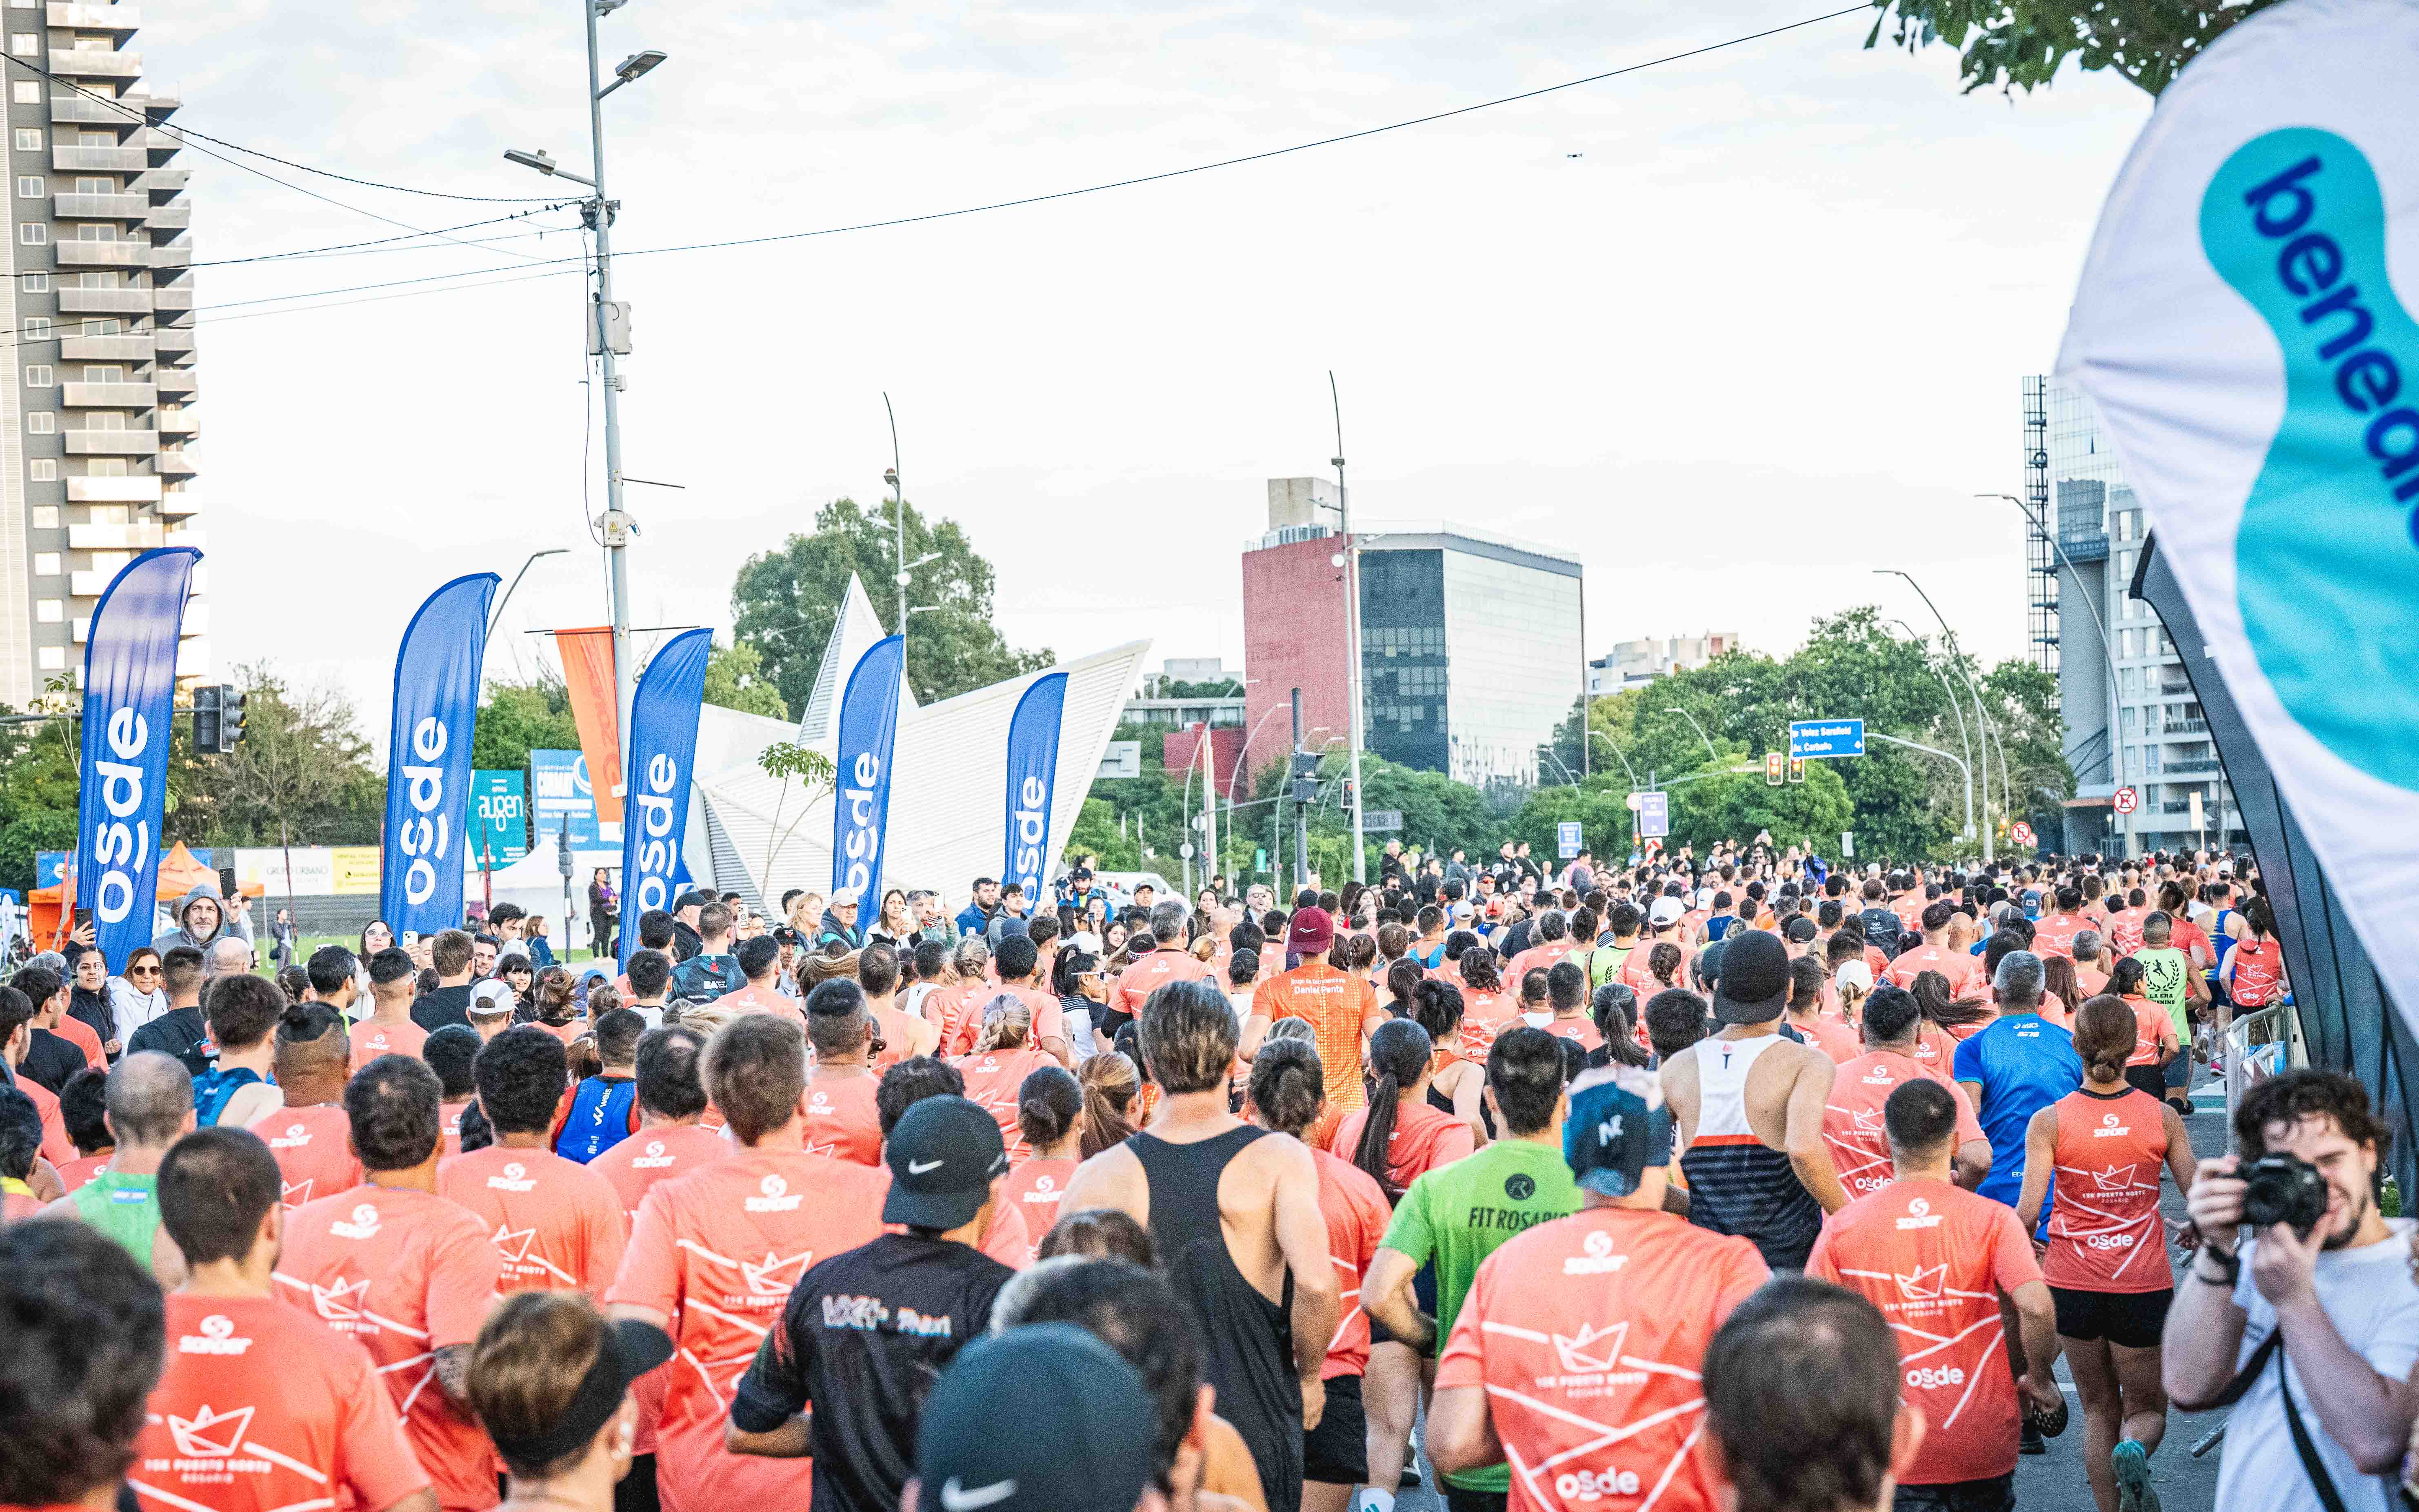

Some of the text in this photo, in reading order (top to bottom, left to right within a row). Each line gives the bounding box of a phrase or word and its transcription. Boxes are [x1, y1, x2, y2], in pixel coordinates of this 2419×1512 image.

[96, 706, 148, 923] osde
[401, 716, 448, 905] osde
[478, 795, 523, 831] augen
[638, 753, 676, 913] osde
[845, 752, 879, 897] osde
[1015, 776, 1046, 909] osde
[1468, 1207, 1495, 1228] FIT
[2087, 1233, 2133, 1250] osde
[1906, 1365, 1964, 1390] osde
[1556, 1466, 1639, 1501] osde
